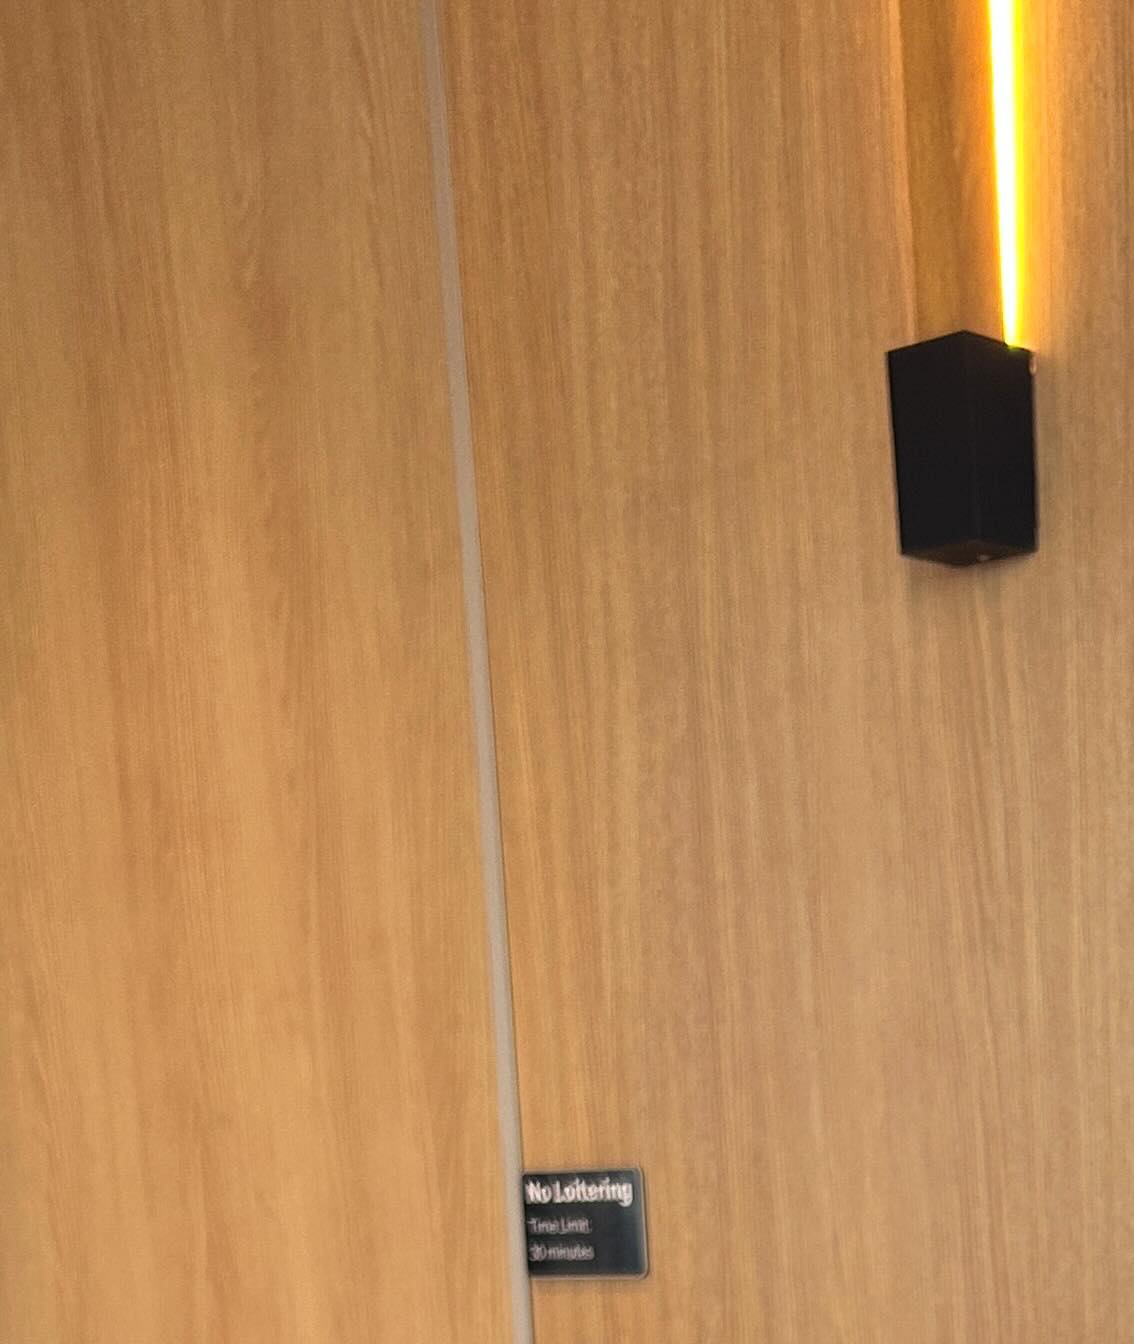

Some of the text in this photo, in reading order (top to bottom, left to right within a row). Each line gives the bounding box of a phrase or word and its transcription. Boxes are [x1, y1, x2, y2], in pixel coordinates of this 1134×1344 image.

[527, 1177, 633, 1207] No Loitering
[527, 1217, 558, 1234] Time
[529, 1243, 595, 1261] 30 minutes
